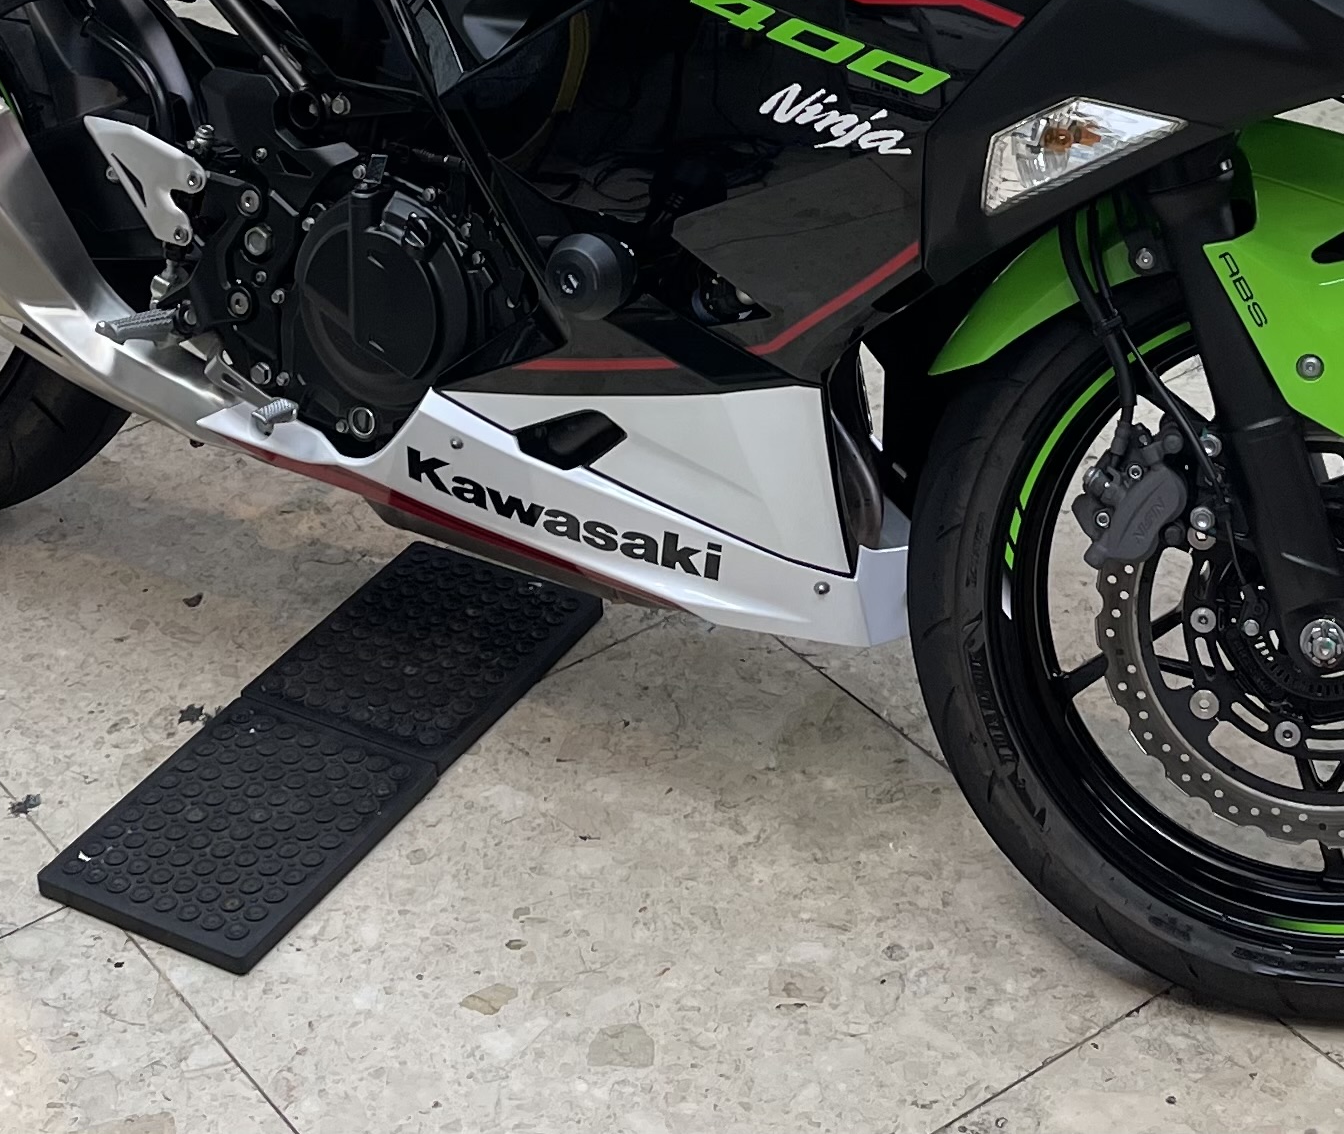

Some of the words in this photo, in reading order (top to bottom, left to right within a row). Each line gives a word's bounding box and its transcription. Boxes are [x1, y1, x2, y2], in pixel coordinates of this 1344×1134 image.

[759, 83, 912, 155] Ninja
[1219, 252, 1268, 327] ABS
[407, 446, 722, 581] Kawasaki
